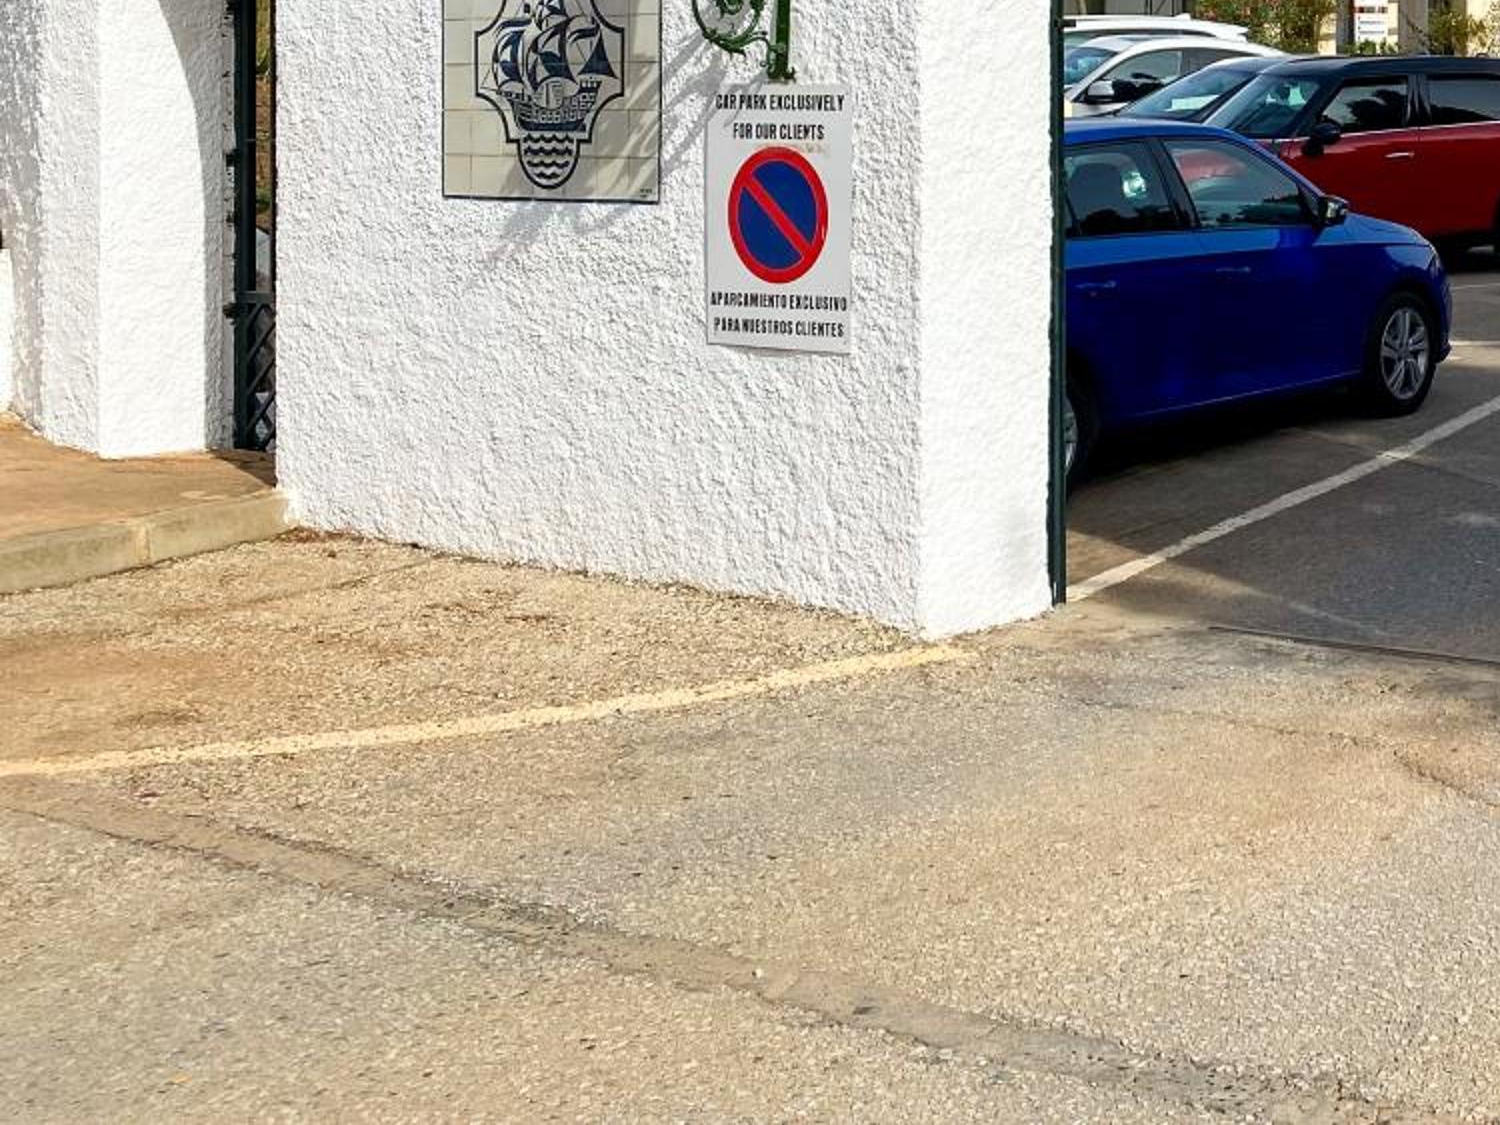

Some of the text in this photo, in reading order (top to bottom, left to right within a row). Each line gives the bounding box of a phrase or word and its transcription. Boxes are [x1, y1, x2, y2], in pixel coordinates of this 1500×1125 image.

[715, 94, 845, 112] CAR PARK EXCLUSIVELY
[733, 122, 825, 140] FOR OUR CLIENTS
[710, 291, 847, 311] APARCAMIENTO EXCLUSIVO
[713, 317, 845, 338] PARA NUESTROS CLIENTES
